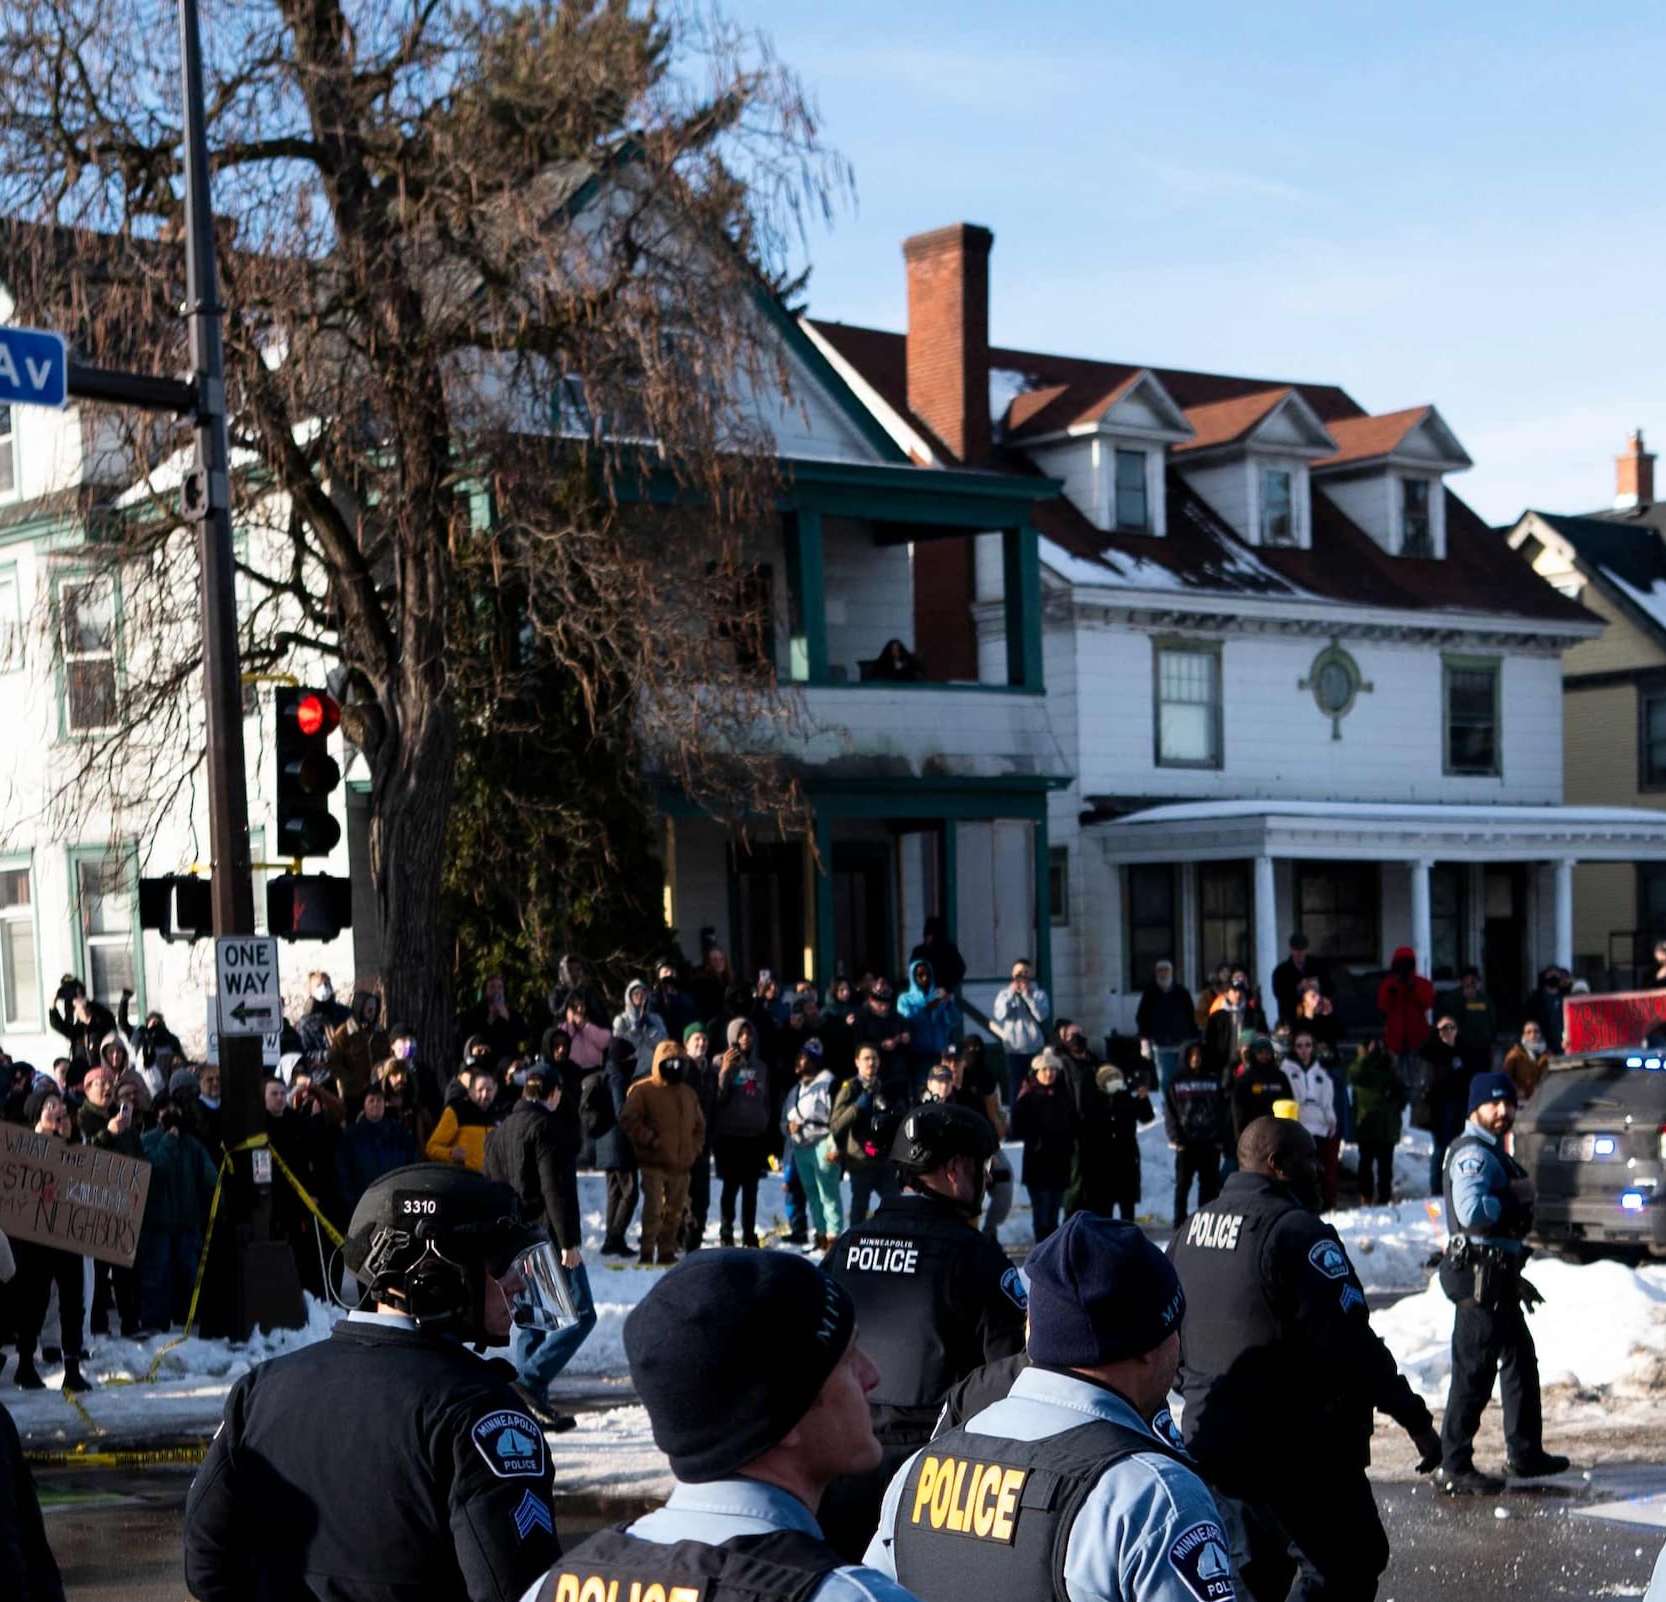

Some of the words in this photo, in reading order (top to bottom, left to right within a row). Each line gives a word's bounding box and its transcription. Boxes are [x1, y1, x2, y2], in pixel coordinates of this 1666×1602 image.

[225, 944, 269, 966] ONE
[224, 971, 270, 995] WAY
[5, 1129, 50, 1160] WHAT
[2, 1163, 55, 1196] STOP
[403, 1200, 436, 1214] 3310
[33, 1198, 137, 1256] NEIGHBORS
[1186, 1212, 1243, 1250] POLICE
[859, 1238, 913, 1248] MINNEAPOLIS
[846, 1247, 919, 1274] POLICE
[477, 1415, 538, 1438] MINNEAPOLIS
[504, 1460, 537, 1471] POLICE
[912, 1456, 1026, 1540] POLICE
